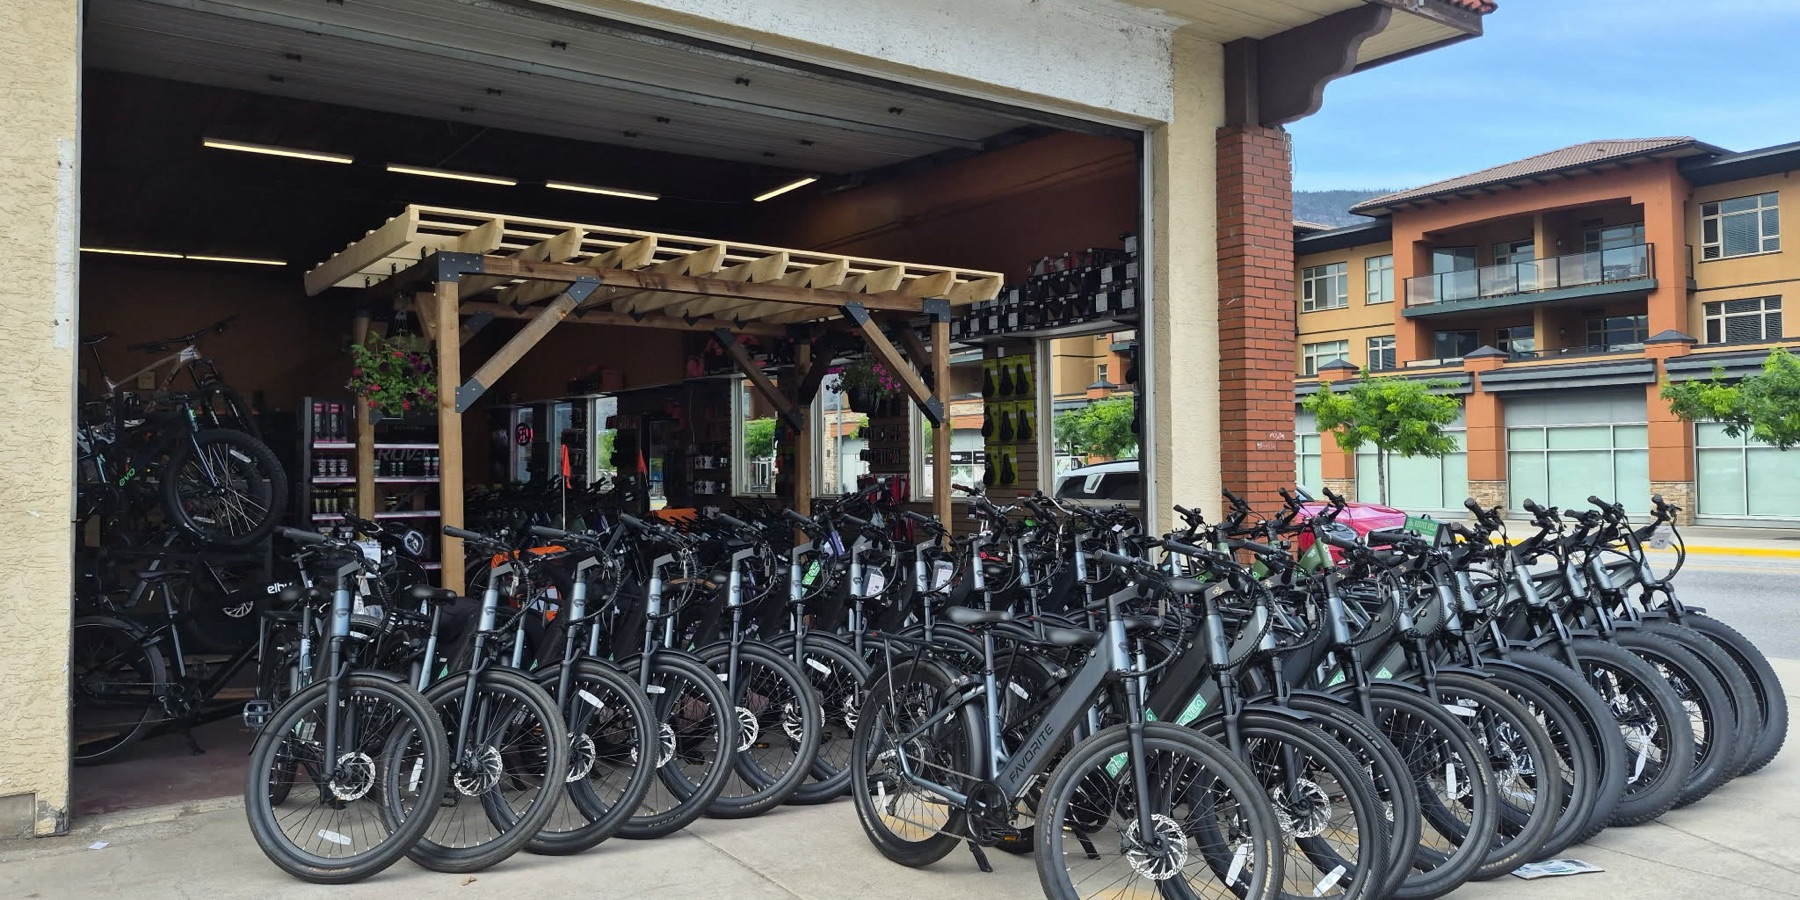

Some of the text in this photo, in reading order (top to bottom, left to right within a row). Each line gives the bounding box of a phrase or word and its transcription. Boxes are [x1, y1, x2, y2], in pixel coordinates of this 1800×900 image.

[119, 467, 136, 487] evo
[1009, 723, 1054, 784] FAVORITE
[1480, 852, 1518, 870] KENDA
